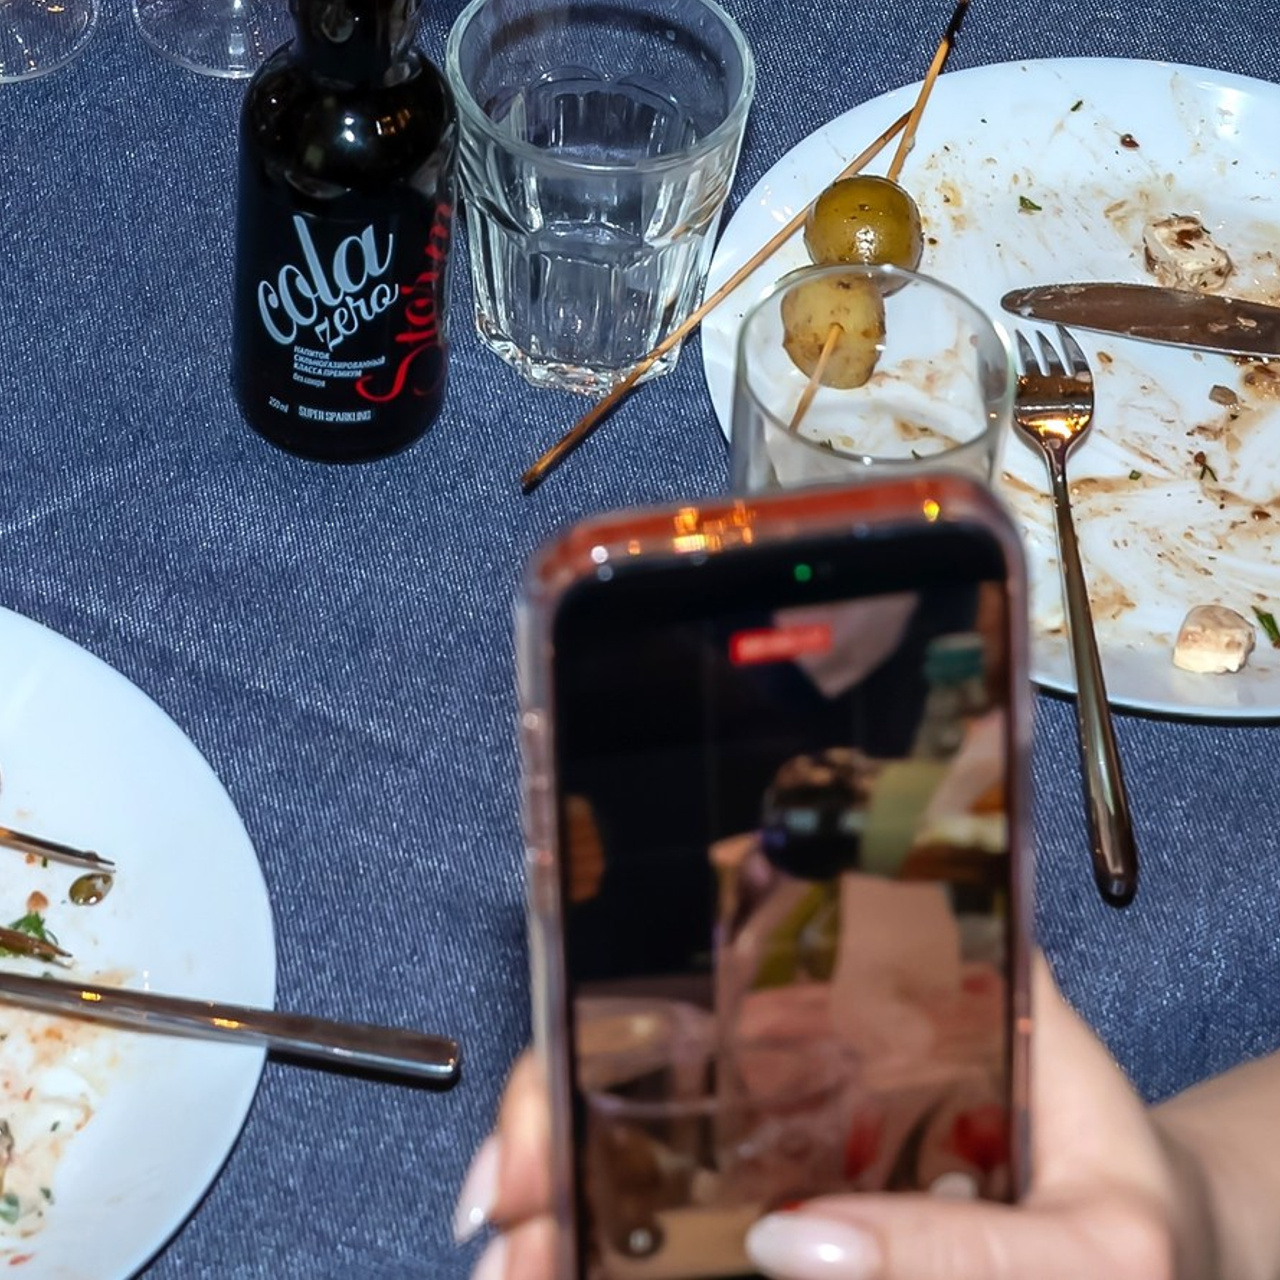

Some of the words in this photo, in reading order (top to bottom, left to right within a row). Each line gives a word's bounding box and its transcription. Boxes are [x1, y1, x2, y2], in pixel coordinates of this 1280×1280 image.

[257, 215, 394, 345] cola
[314, 283, 400, 352] zero
[293, 344, 330, 360] НАПИТОК
[293, 362, 322, 376] КЛАССА
[298, 405, 324, 421] SUPER
[325, 409, 372, 422] SPARKLING
